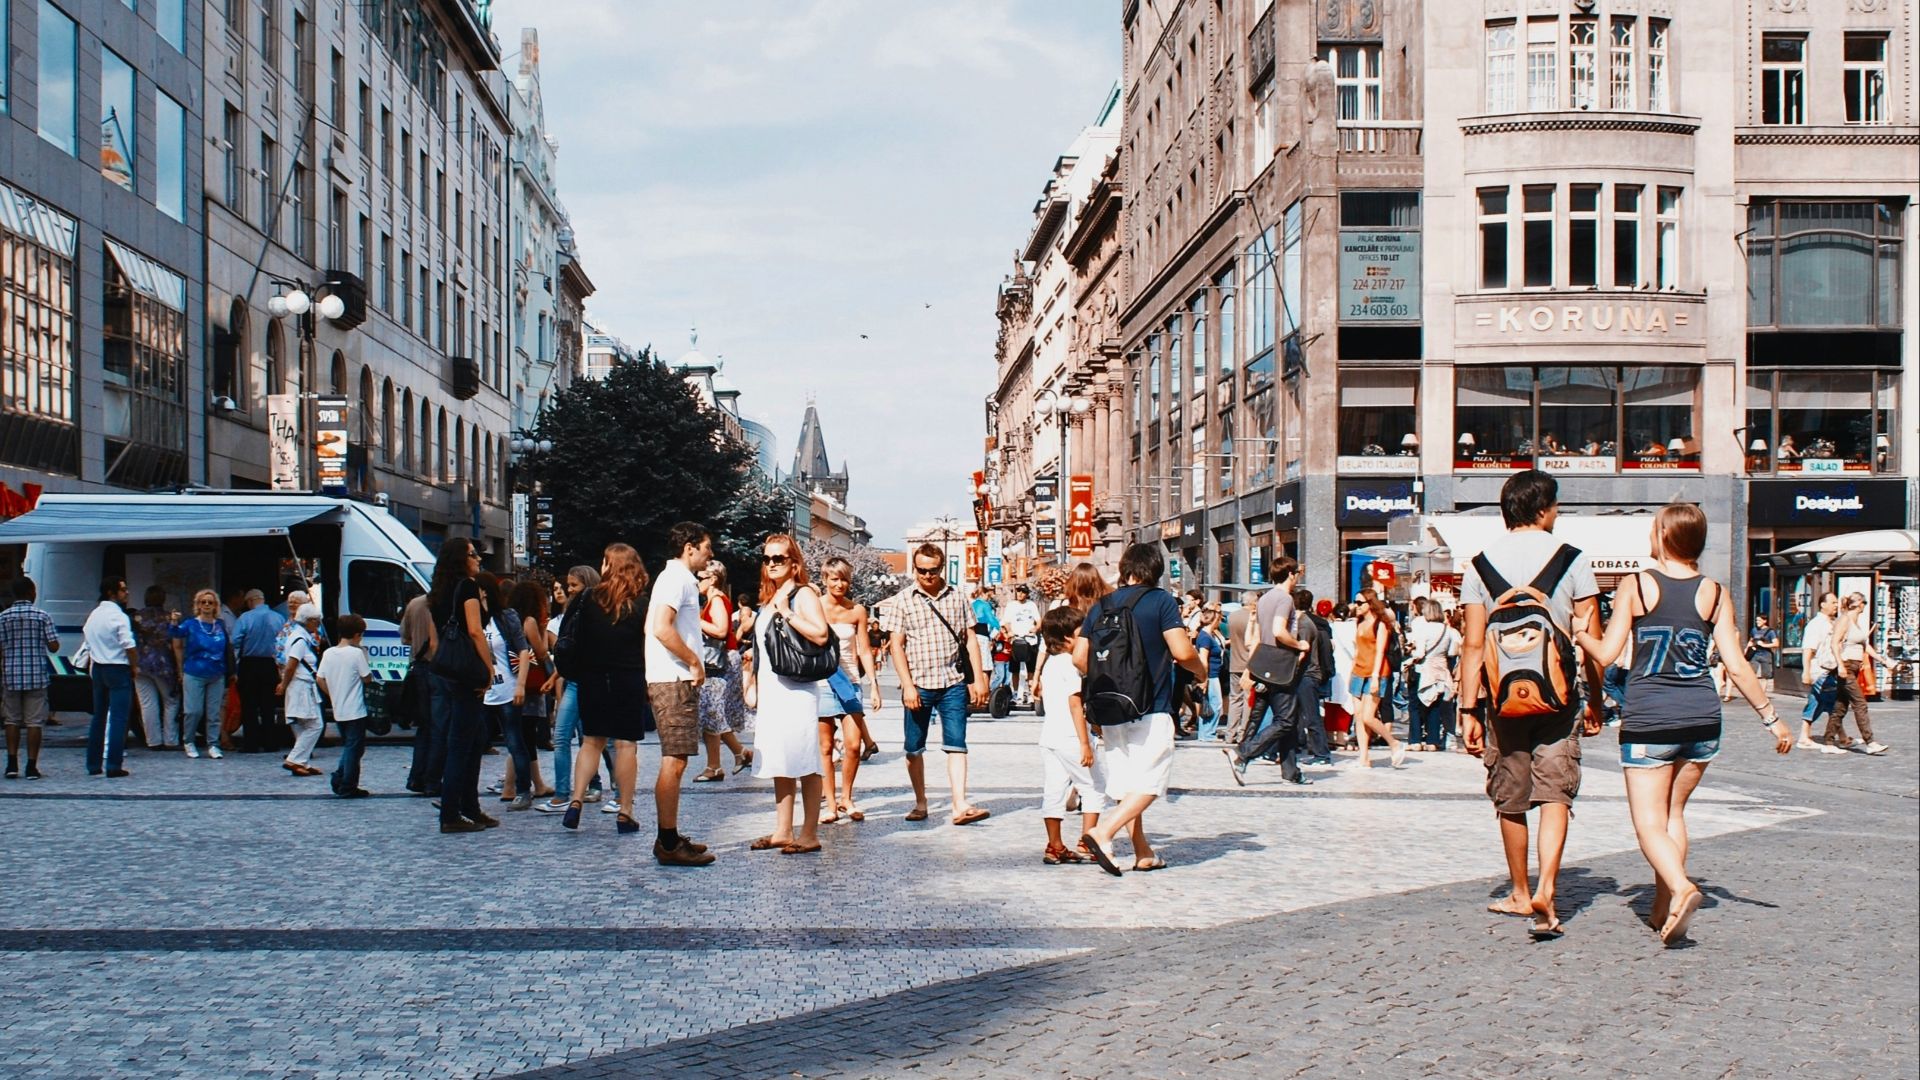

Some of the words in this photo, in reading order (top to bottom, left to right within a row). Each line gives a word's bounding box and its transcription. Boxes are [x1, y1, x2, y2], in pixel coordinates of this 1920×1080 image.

[1353, 279, 1368, 290] 224
[1371, 279, 1387, 290] 217
[1390, 279, 1405, 290] 217
[1350, 304, 1368, 316] 234
[1370, 304, 1388, 316] 603
[1390, 304, 1408, 316] 603
[1499, 306, 1668, 333] KORUNA
[1545, 460, 1569, 469] PIZZA
[1579, 460, 1606, 469] PASTA
[1810, 463, 1838, 471] SALAD
[1591, 560, 1639, 568] LOBASA
[1637, 625, 1710, 678] 73
